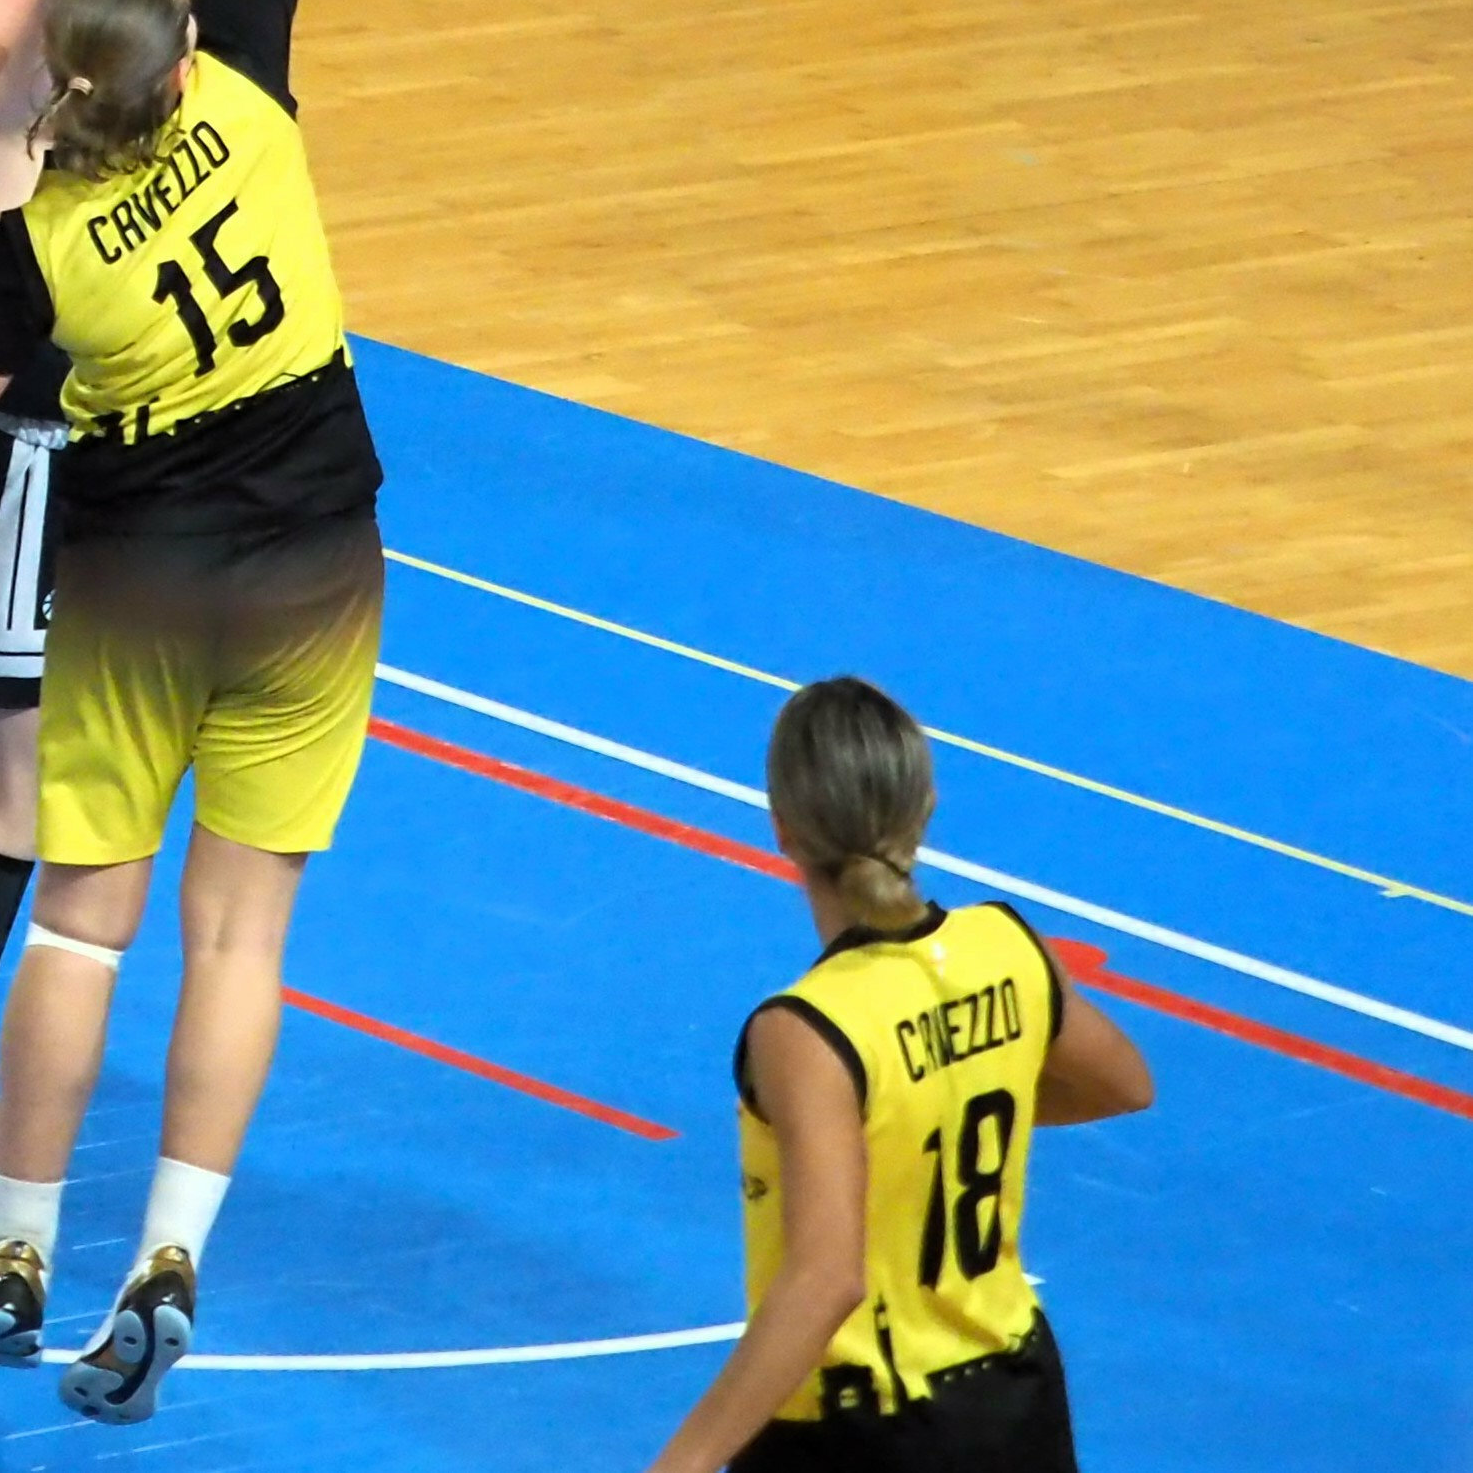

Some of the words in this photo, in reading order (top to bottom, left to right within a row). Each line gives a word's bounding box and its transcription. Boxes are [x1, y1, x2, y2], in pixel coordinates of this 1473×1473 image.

[87, 121, 230, 265] CAVEZZO
[151, 197, 286, 378] 15
[918, 1088, 1016, 1291] 18
